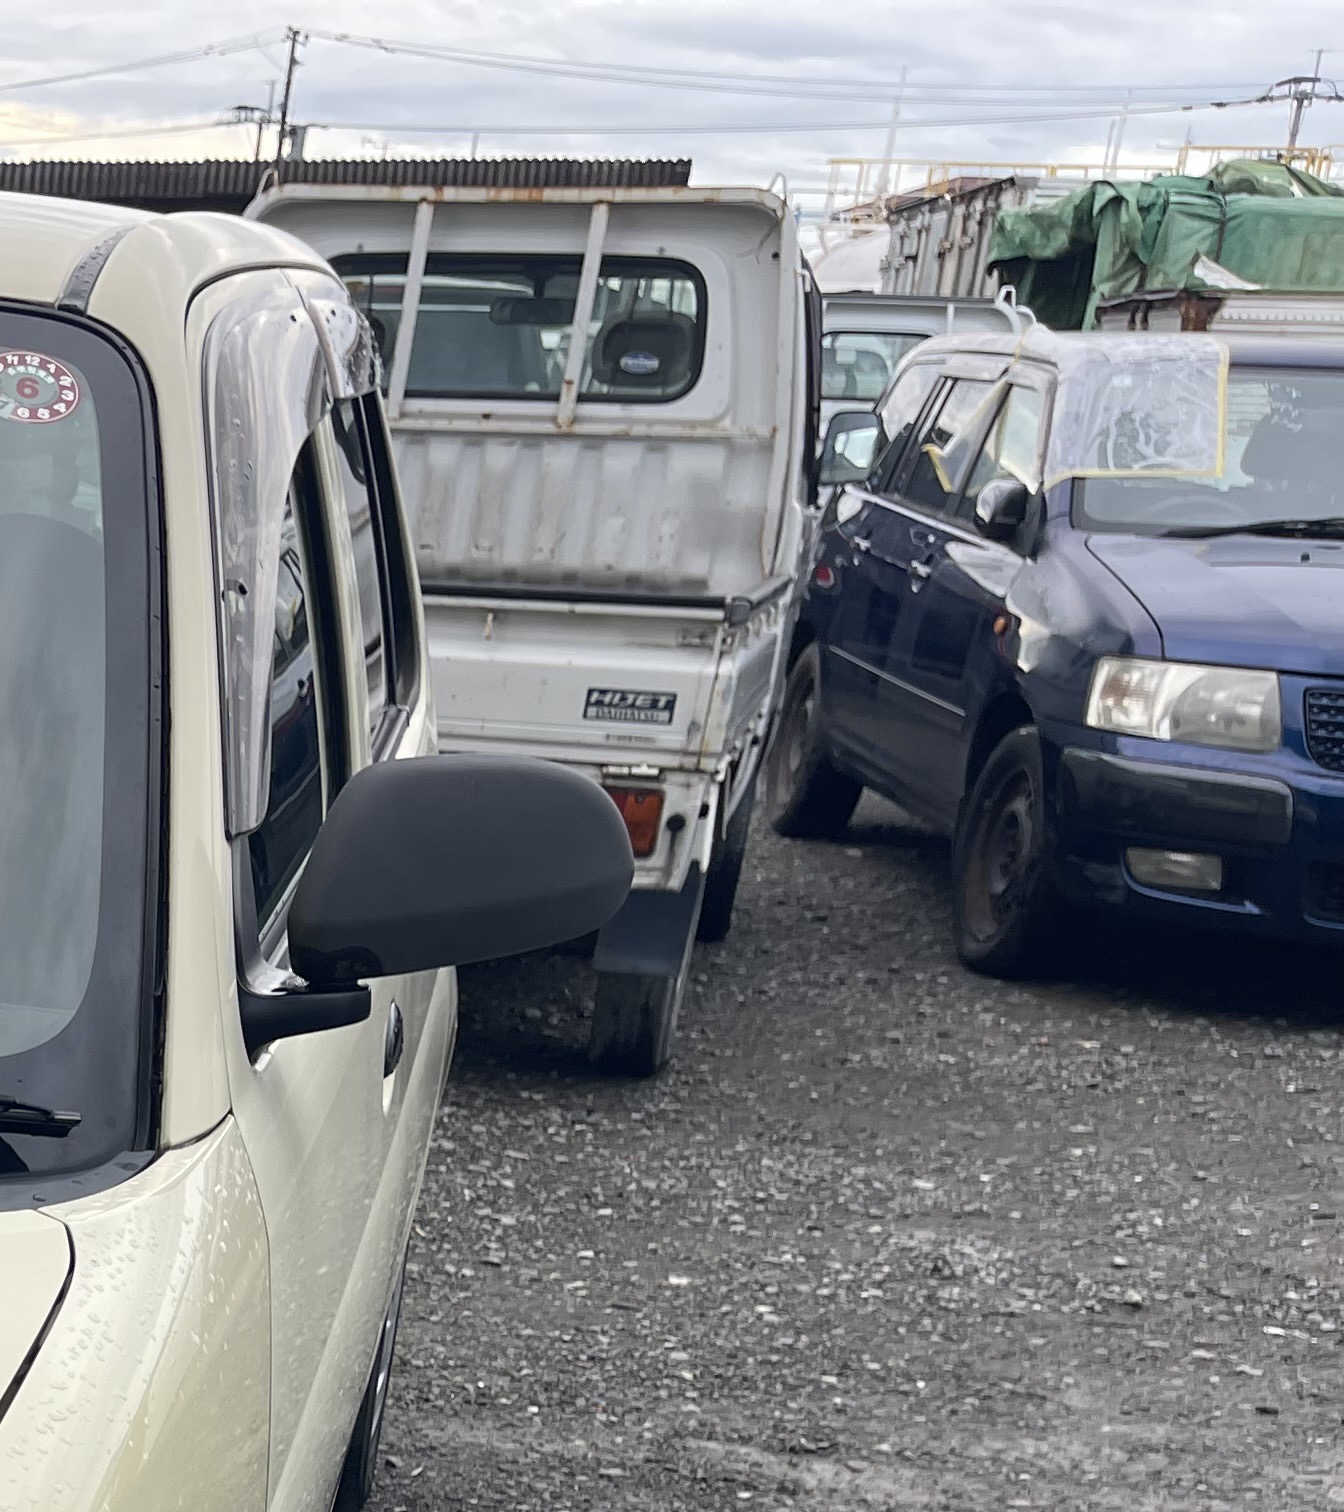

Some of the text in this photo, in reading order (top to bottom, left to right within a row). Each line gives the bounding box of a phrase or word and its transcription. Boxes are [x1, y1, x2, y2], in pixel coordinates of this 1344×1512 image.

[6, 355, 19, 365] 11
[25, 355, 41, 366] 12
[59, 376, 72, 387] 2
[16, 377, 40, 399] 6
[61, 390, 75, 401] 3
[17, 407, 30, 418] 6
[53, 403, 67, 413] 4
[591, 692, 673, 709] HIJET
